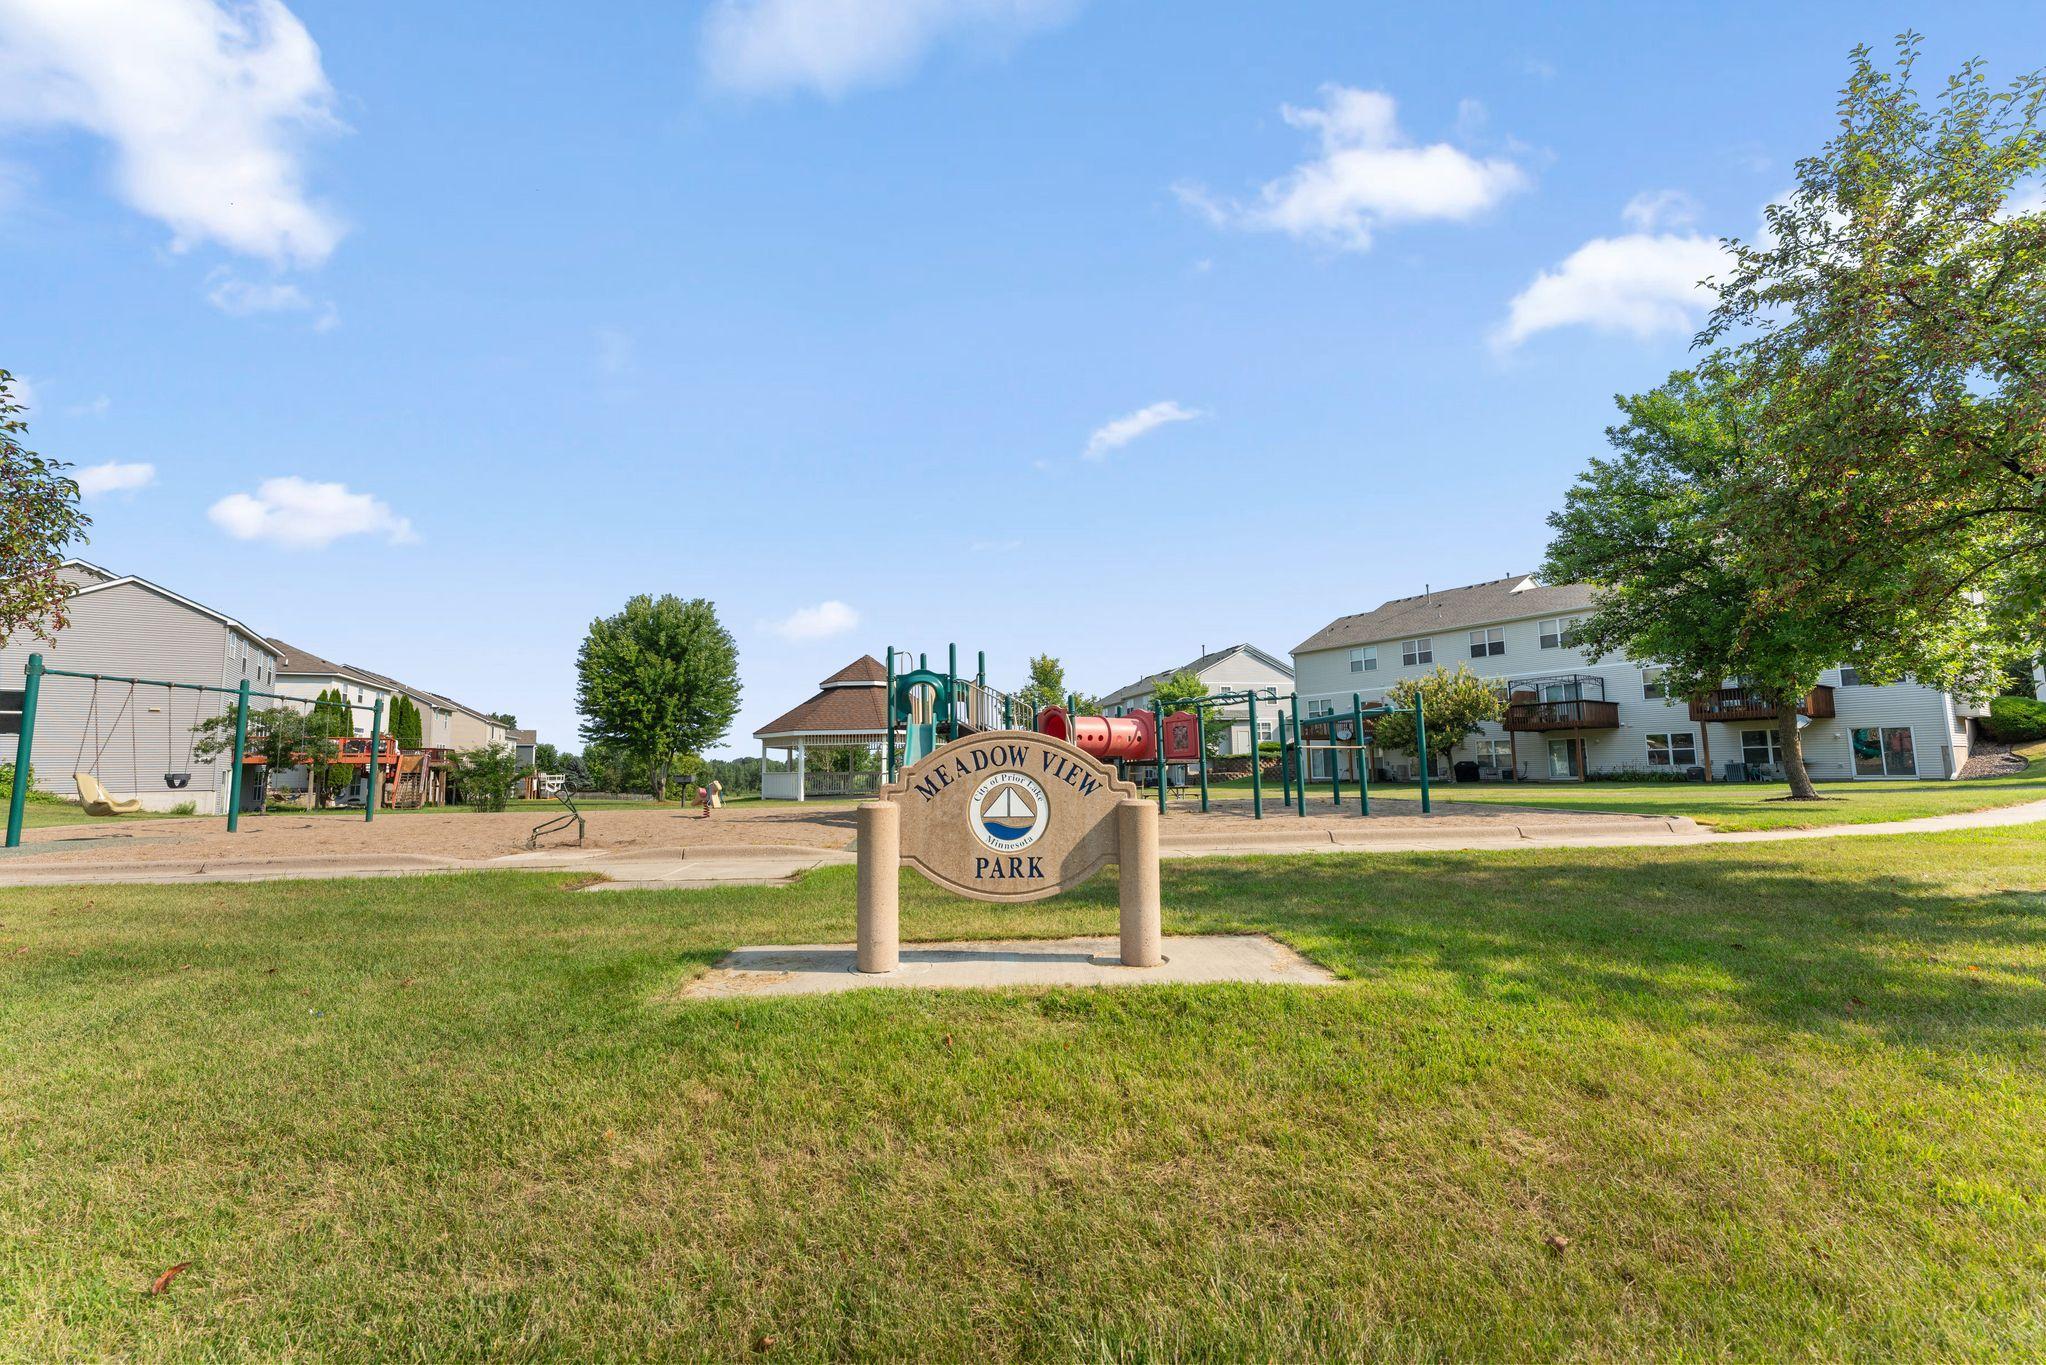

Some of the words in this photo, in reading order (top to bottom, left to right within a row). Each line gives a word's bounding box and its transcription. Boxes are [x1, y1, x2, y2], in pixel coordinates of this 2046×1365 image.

[914, 745, 1030, 802] MEADOW
[1042, 751, 1103, 799] VIEW
[974, 785, 988, 802] City
[990, 776, 999, 785] of
[1001, 774, 1025, 783] Prior
[1027, 781, 1043, 802] Lake
[986, 835, 1033, 850] Minnesota
[975, 856, 1045, 879] PARK
